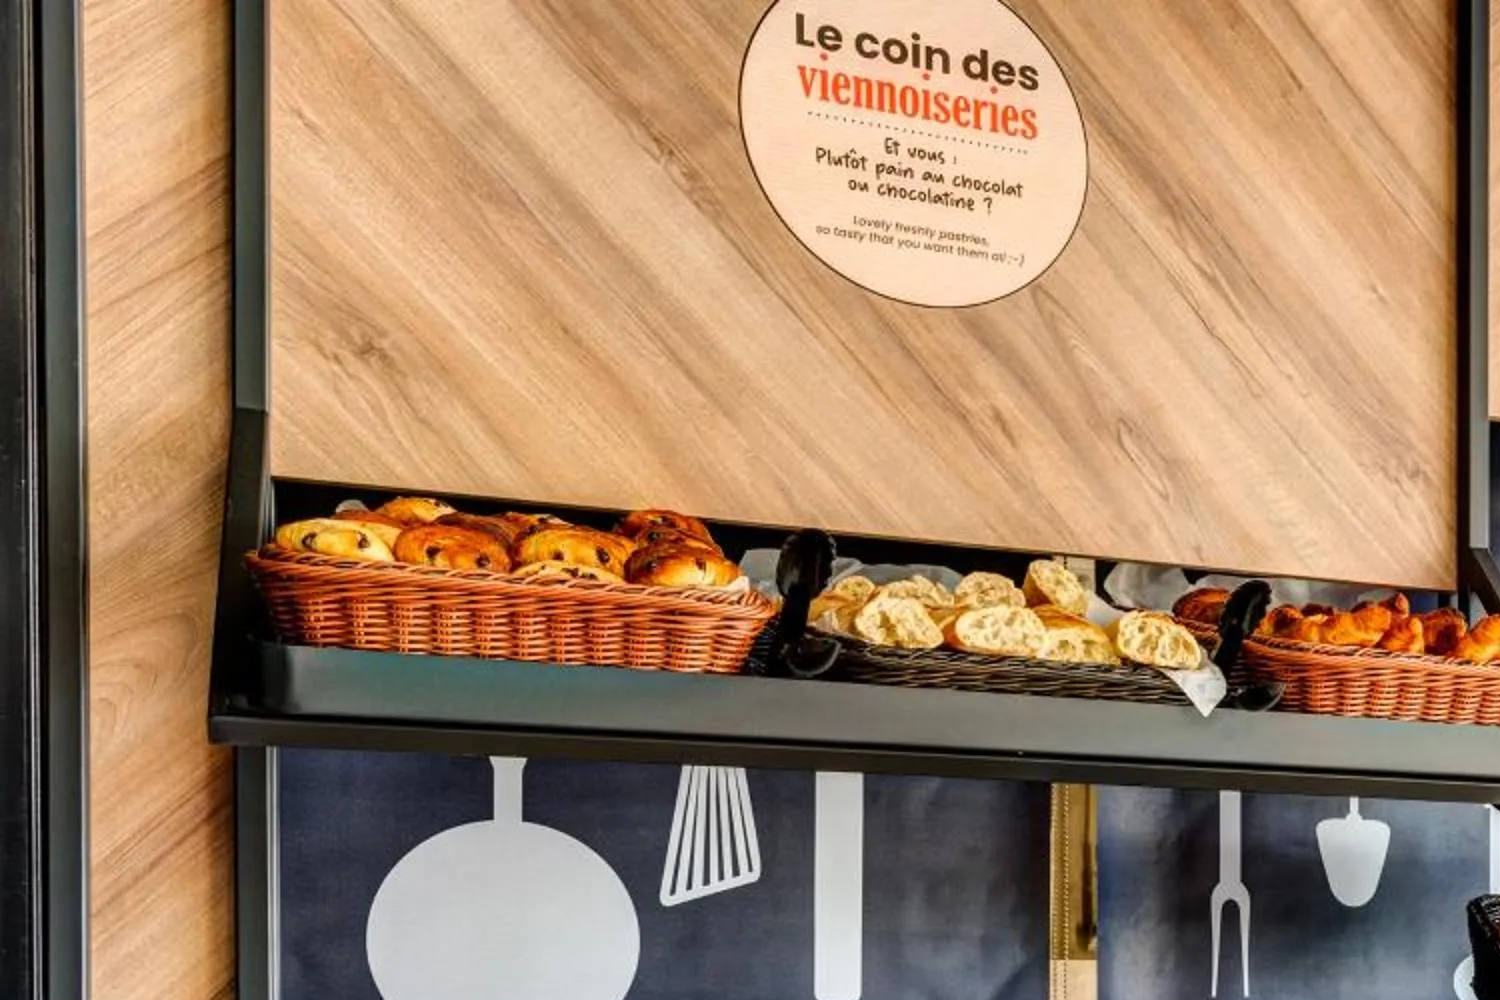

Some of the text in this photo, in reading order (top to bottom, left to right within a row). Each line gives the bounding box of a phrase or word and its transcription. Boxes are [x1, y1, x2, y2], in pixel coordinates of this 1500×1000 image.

[794, 12, 1039, 91] Le coin des
[797, 52, 1039, 141] viennoiseries
[884, 137, 901, 156] Et
[907, 147, 946, 165] vous
[815, 146, 1024, 198] Plutôt pain au chocolat
[848, 180, 869, 193] ou
[877, 182, 975, 212] chocolatine
[853, 215, 893, 232] Lovely
[815, 225, 831, 235] so
[833, 228, 866, 243] tasty
[869, 232, 894, 245] that
[897, 238, 920, 251] you
[923, 243, 954, 255] want
[957, 246, 989, 261] them
